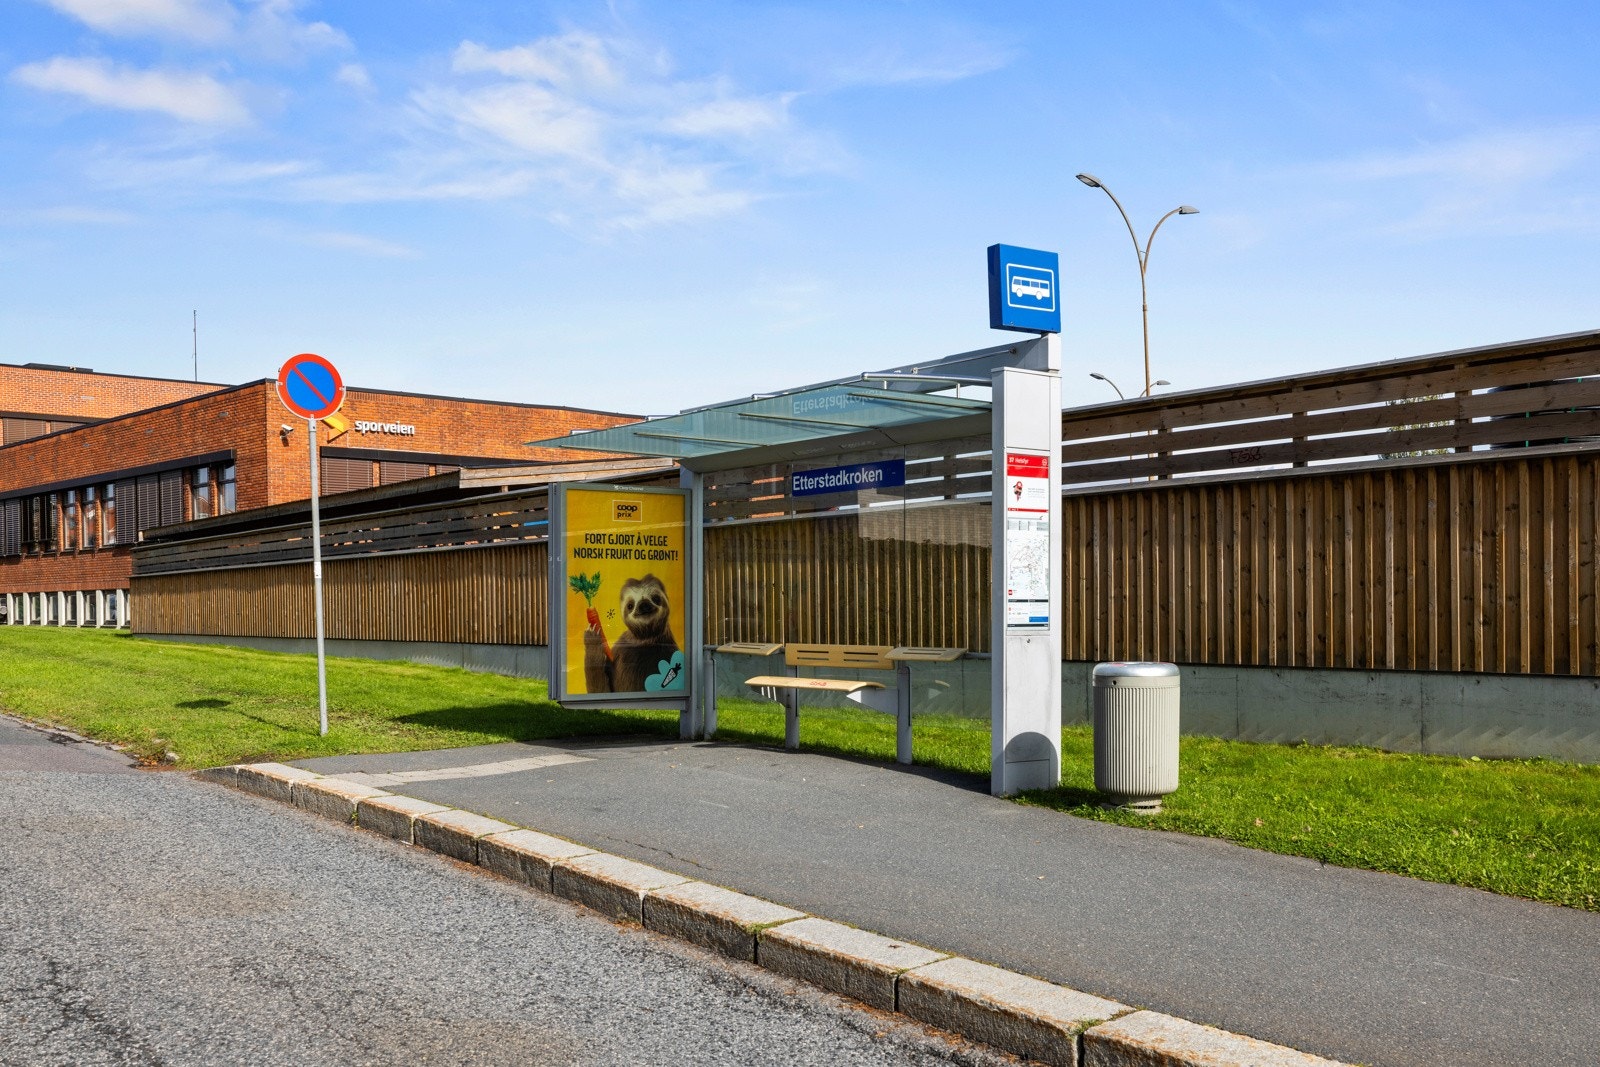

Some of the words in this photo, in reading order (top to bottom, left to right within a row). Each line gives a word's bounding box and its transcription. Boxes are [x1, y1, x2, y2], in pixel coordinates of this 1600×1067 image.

[354, 420, 415, 435] sporveien
[793, 468, 883, 491] Etterstadkroken
[585, 533, 606, 544] FORT
[608, 533, 635, 546] GJORT
[636, 532, 643, 546] Å
[643, 535, 668, 547] VELGE
[573, 547, 604, 559] NORSK
[605, 548, 632, 560] FRUKT
[634, 549, 646, 560] OG
[647, 549, 679, 561] GRØNT!
